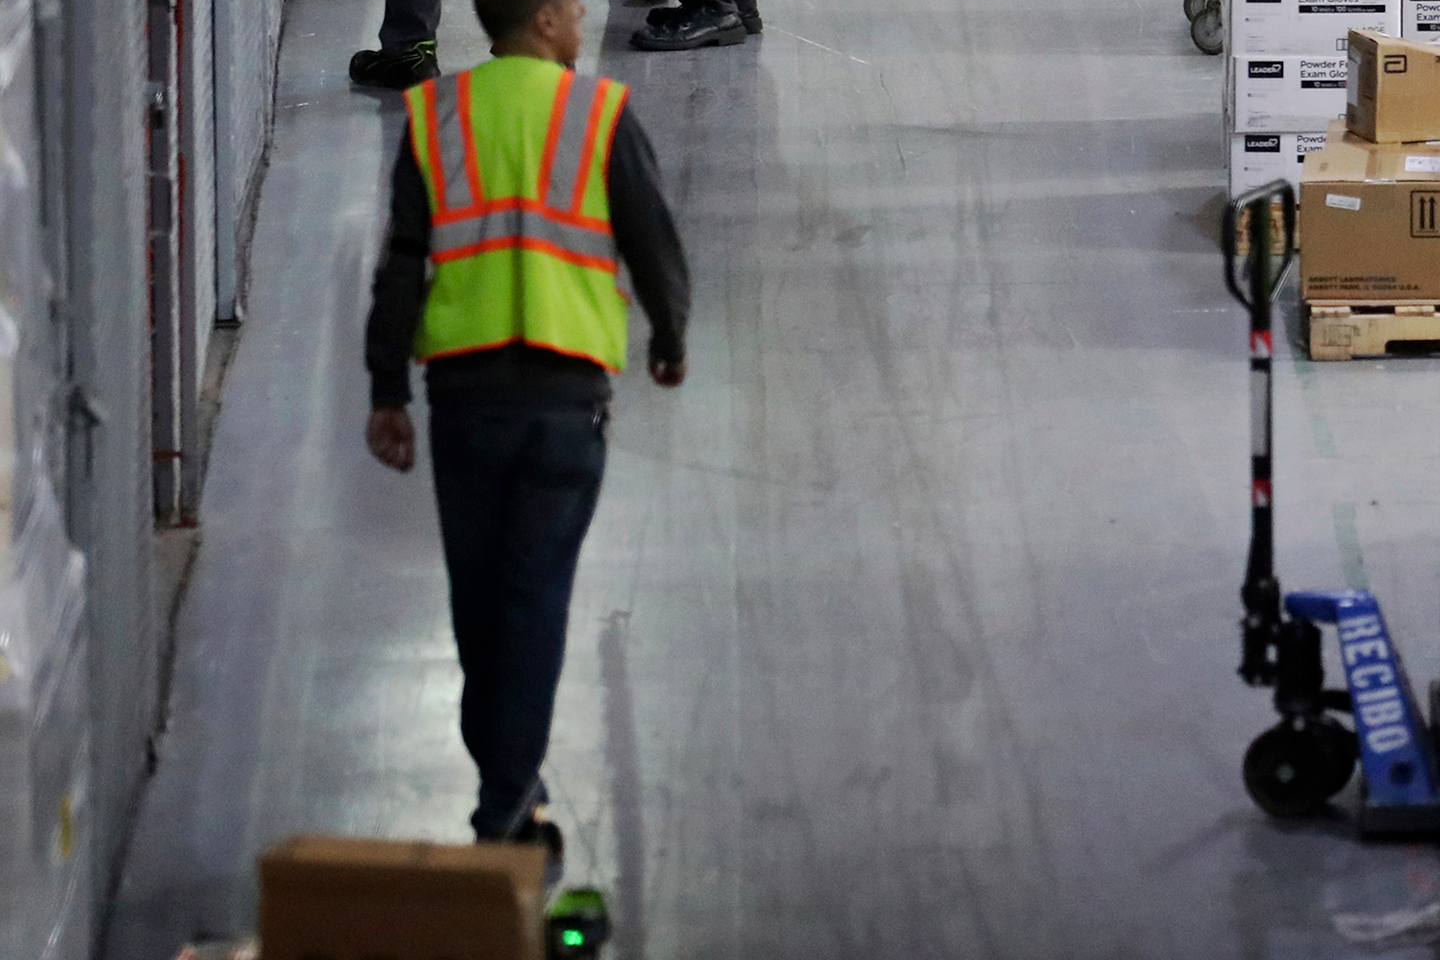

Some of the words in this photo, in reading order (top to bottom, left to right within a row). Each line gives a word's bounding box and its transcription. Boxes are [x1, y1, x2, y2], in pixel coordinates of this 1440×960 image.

[1300, 60, 1336, 69] Powder
[1300, 70, 1327, 79] Exam
[1339, 614, 1410, 753] RECIBO
